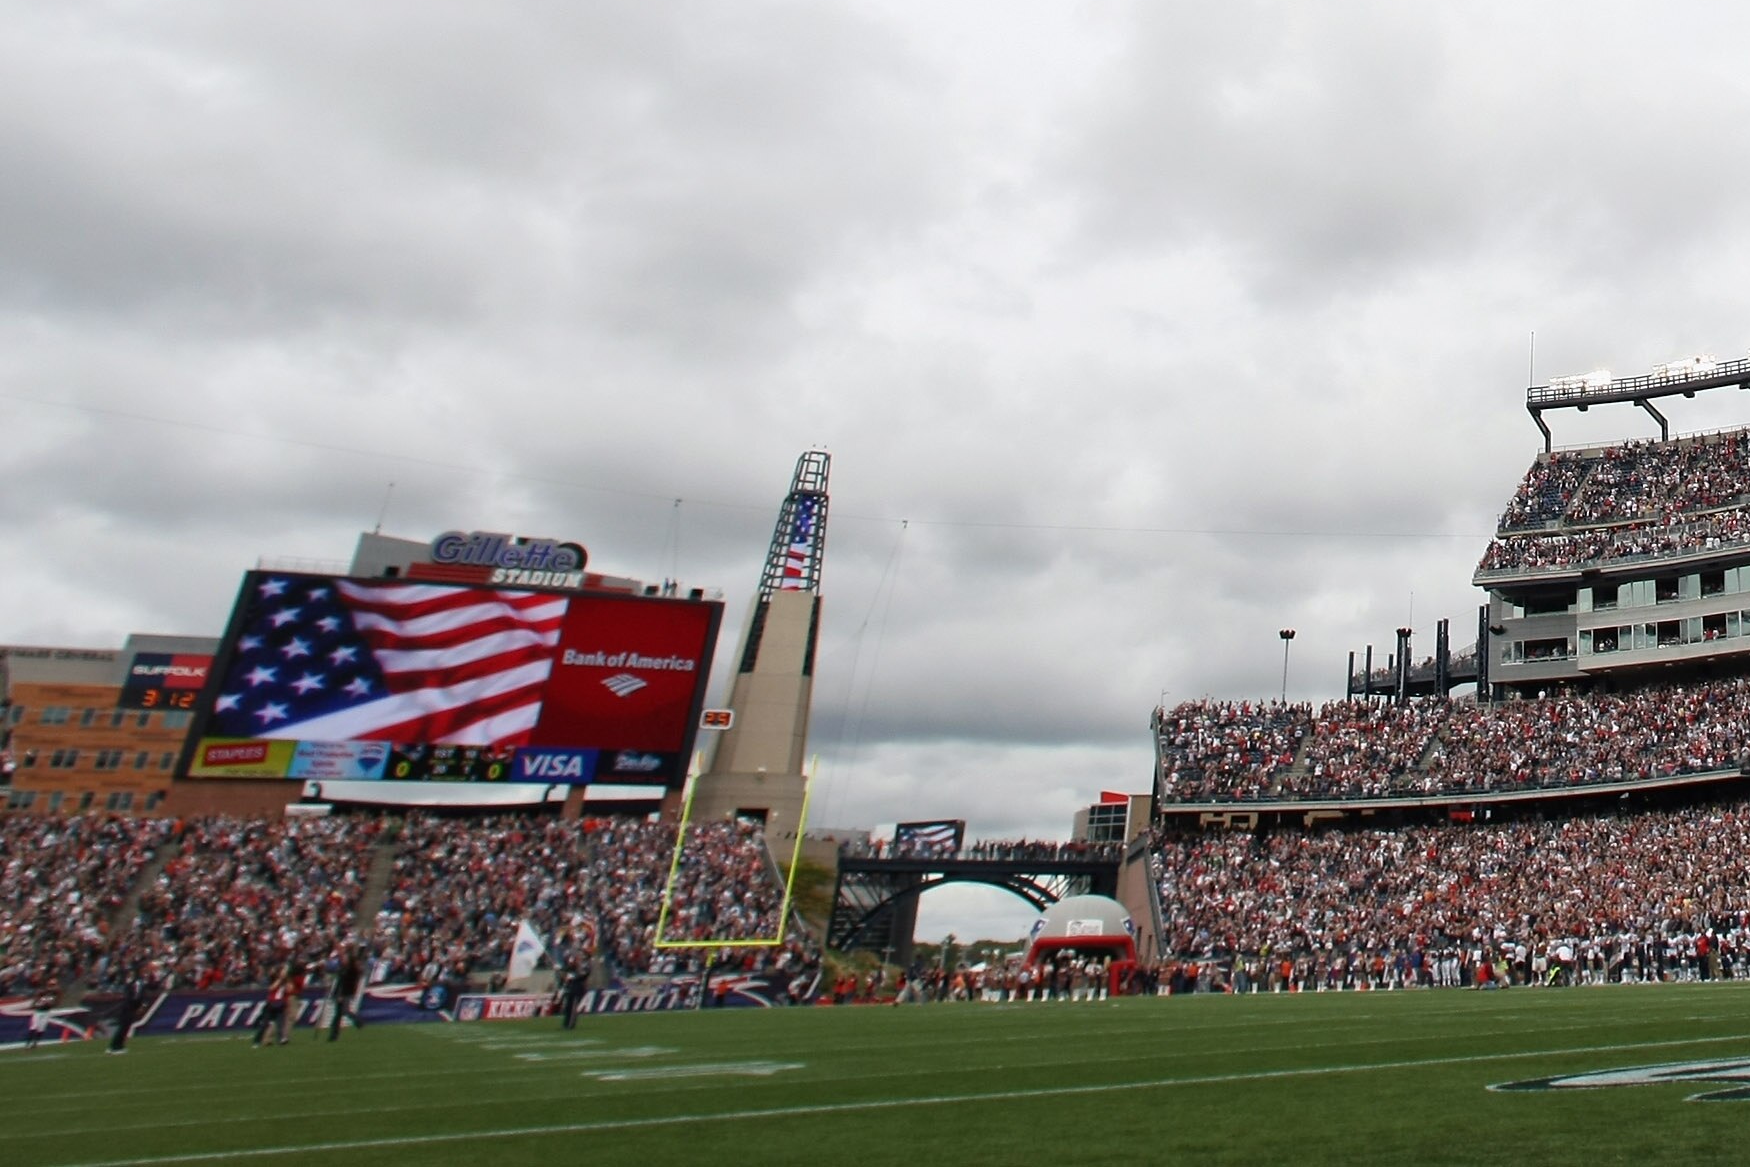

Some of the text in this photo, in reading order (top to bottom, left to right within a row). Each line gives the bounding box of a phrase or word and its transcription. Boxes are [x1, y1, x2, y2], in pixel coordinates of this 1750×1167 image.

[433, 535, 574, 572] Gillette
[491, 569, 582, 588] STADIUM
[132, 664, 207, 677] SUFFOLK
[562, 649, 695, 671] Bank of America
[522, 753, 583, 777] VISA
